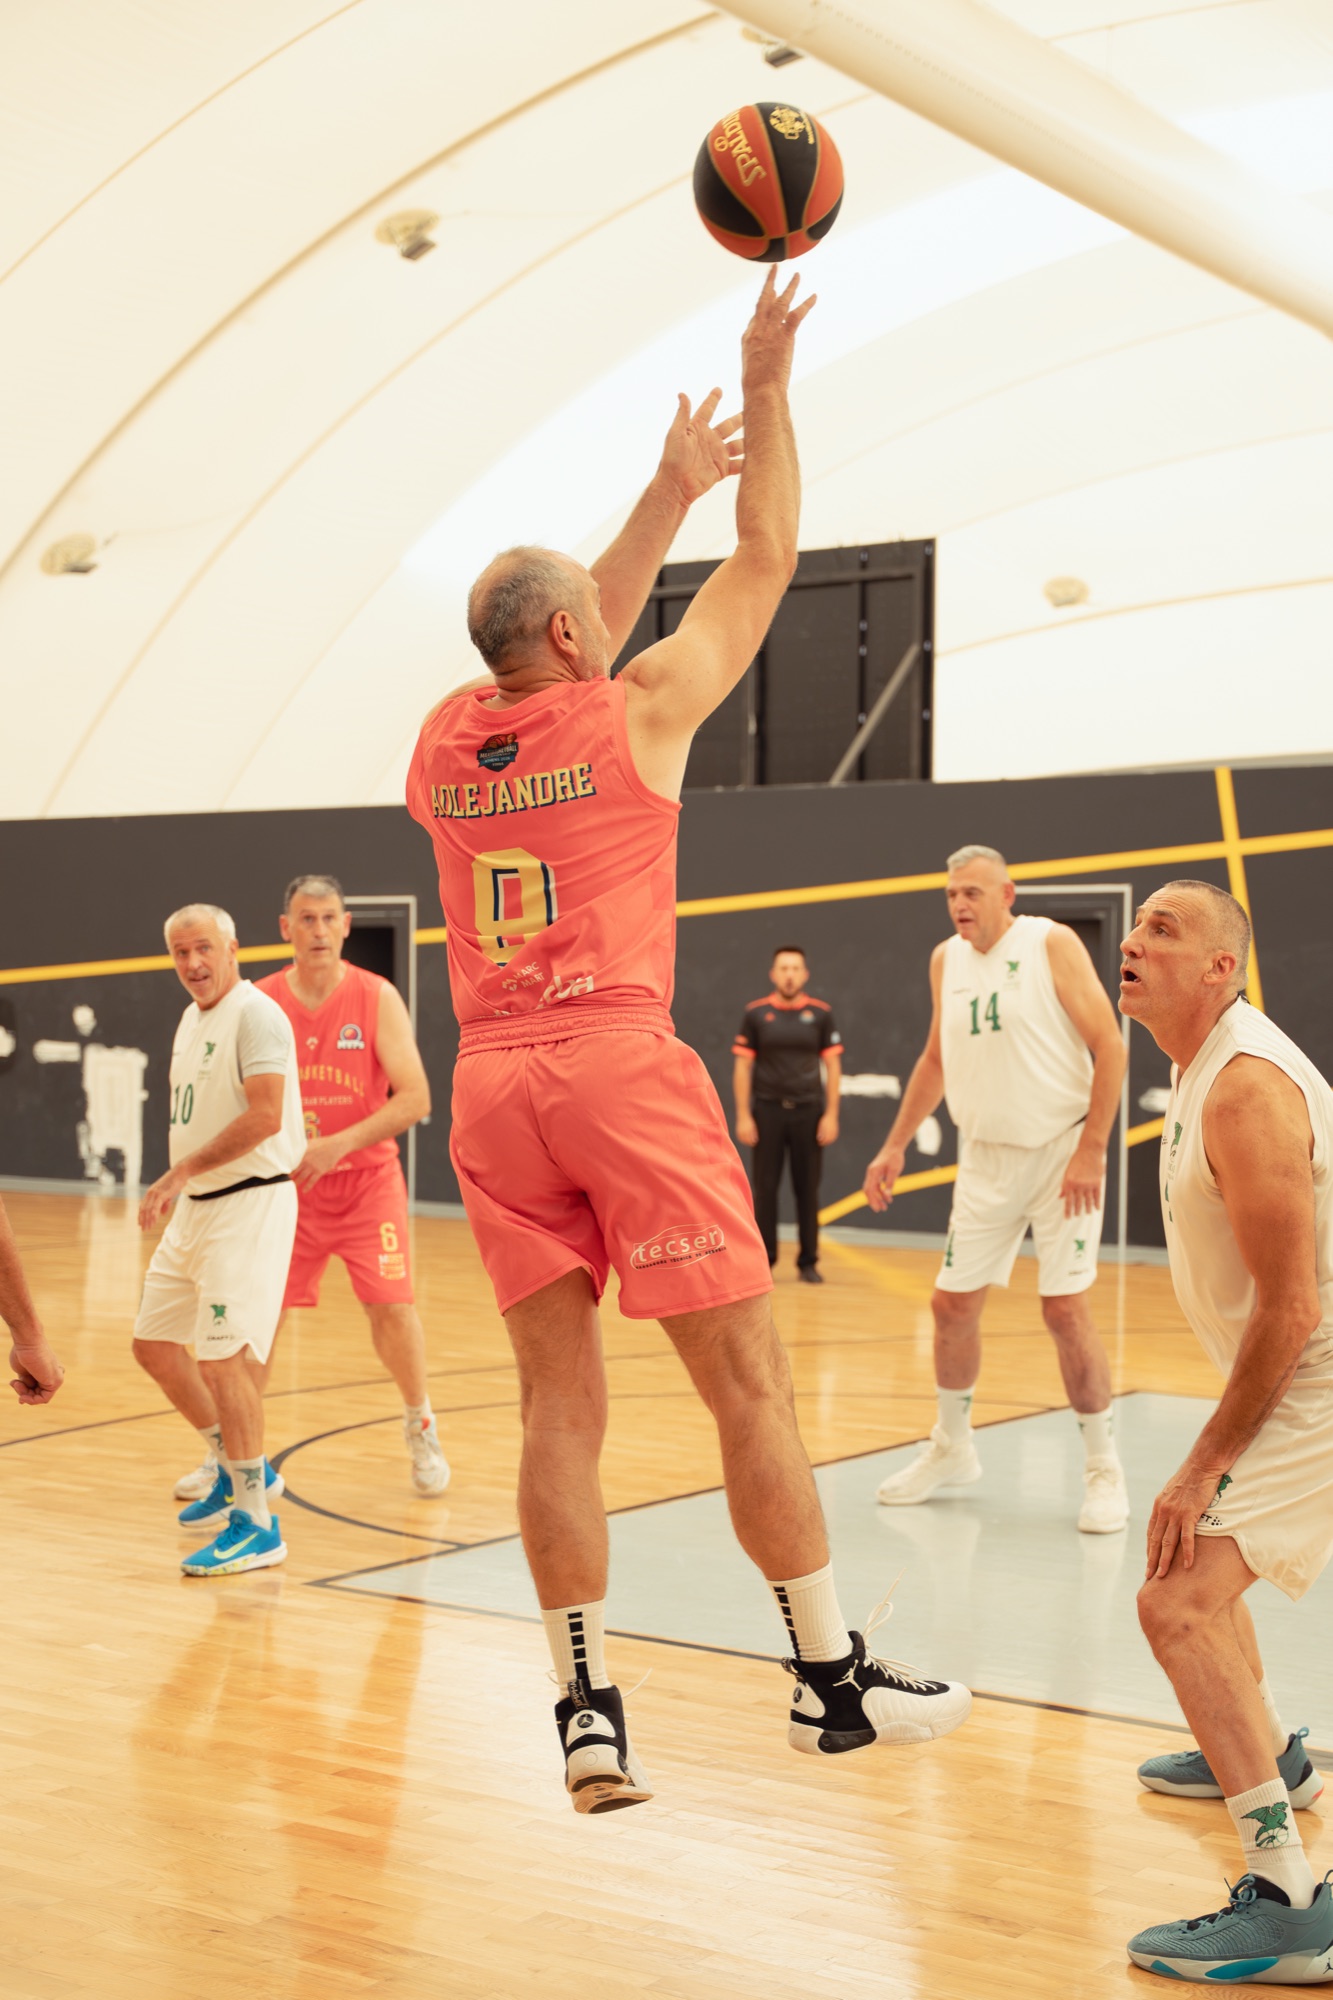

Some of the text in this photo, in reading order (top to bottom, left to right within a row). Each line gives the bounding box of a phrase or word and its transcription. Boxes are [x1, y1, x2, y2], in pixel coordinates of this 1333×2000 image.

[970, 991, 1002, 1035] 14
[170, 1083, 194, 1125] 10
[379, 1221, 398, 1252] 6
[638, 1230, 718, 1262] tecser
